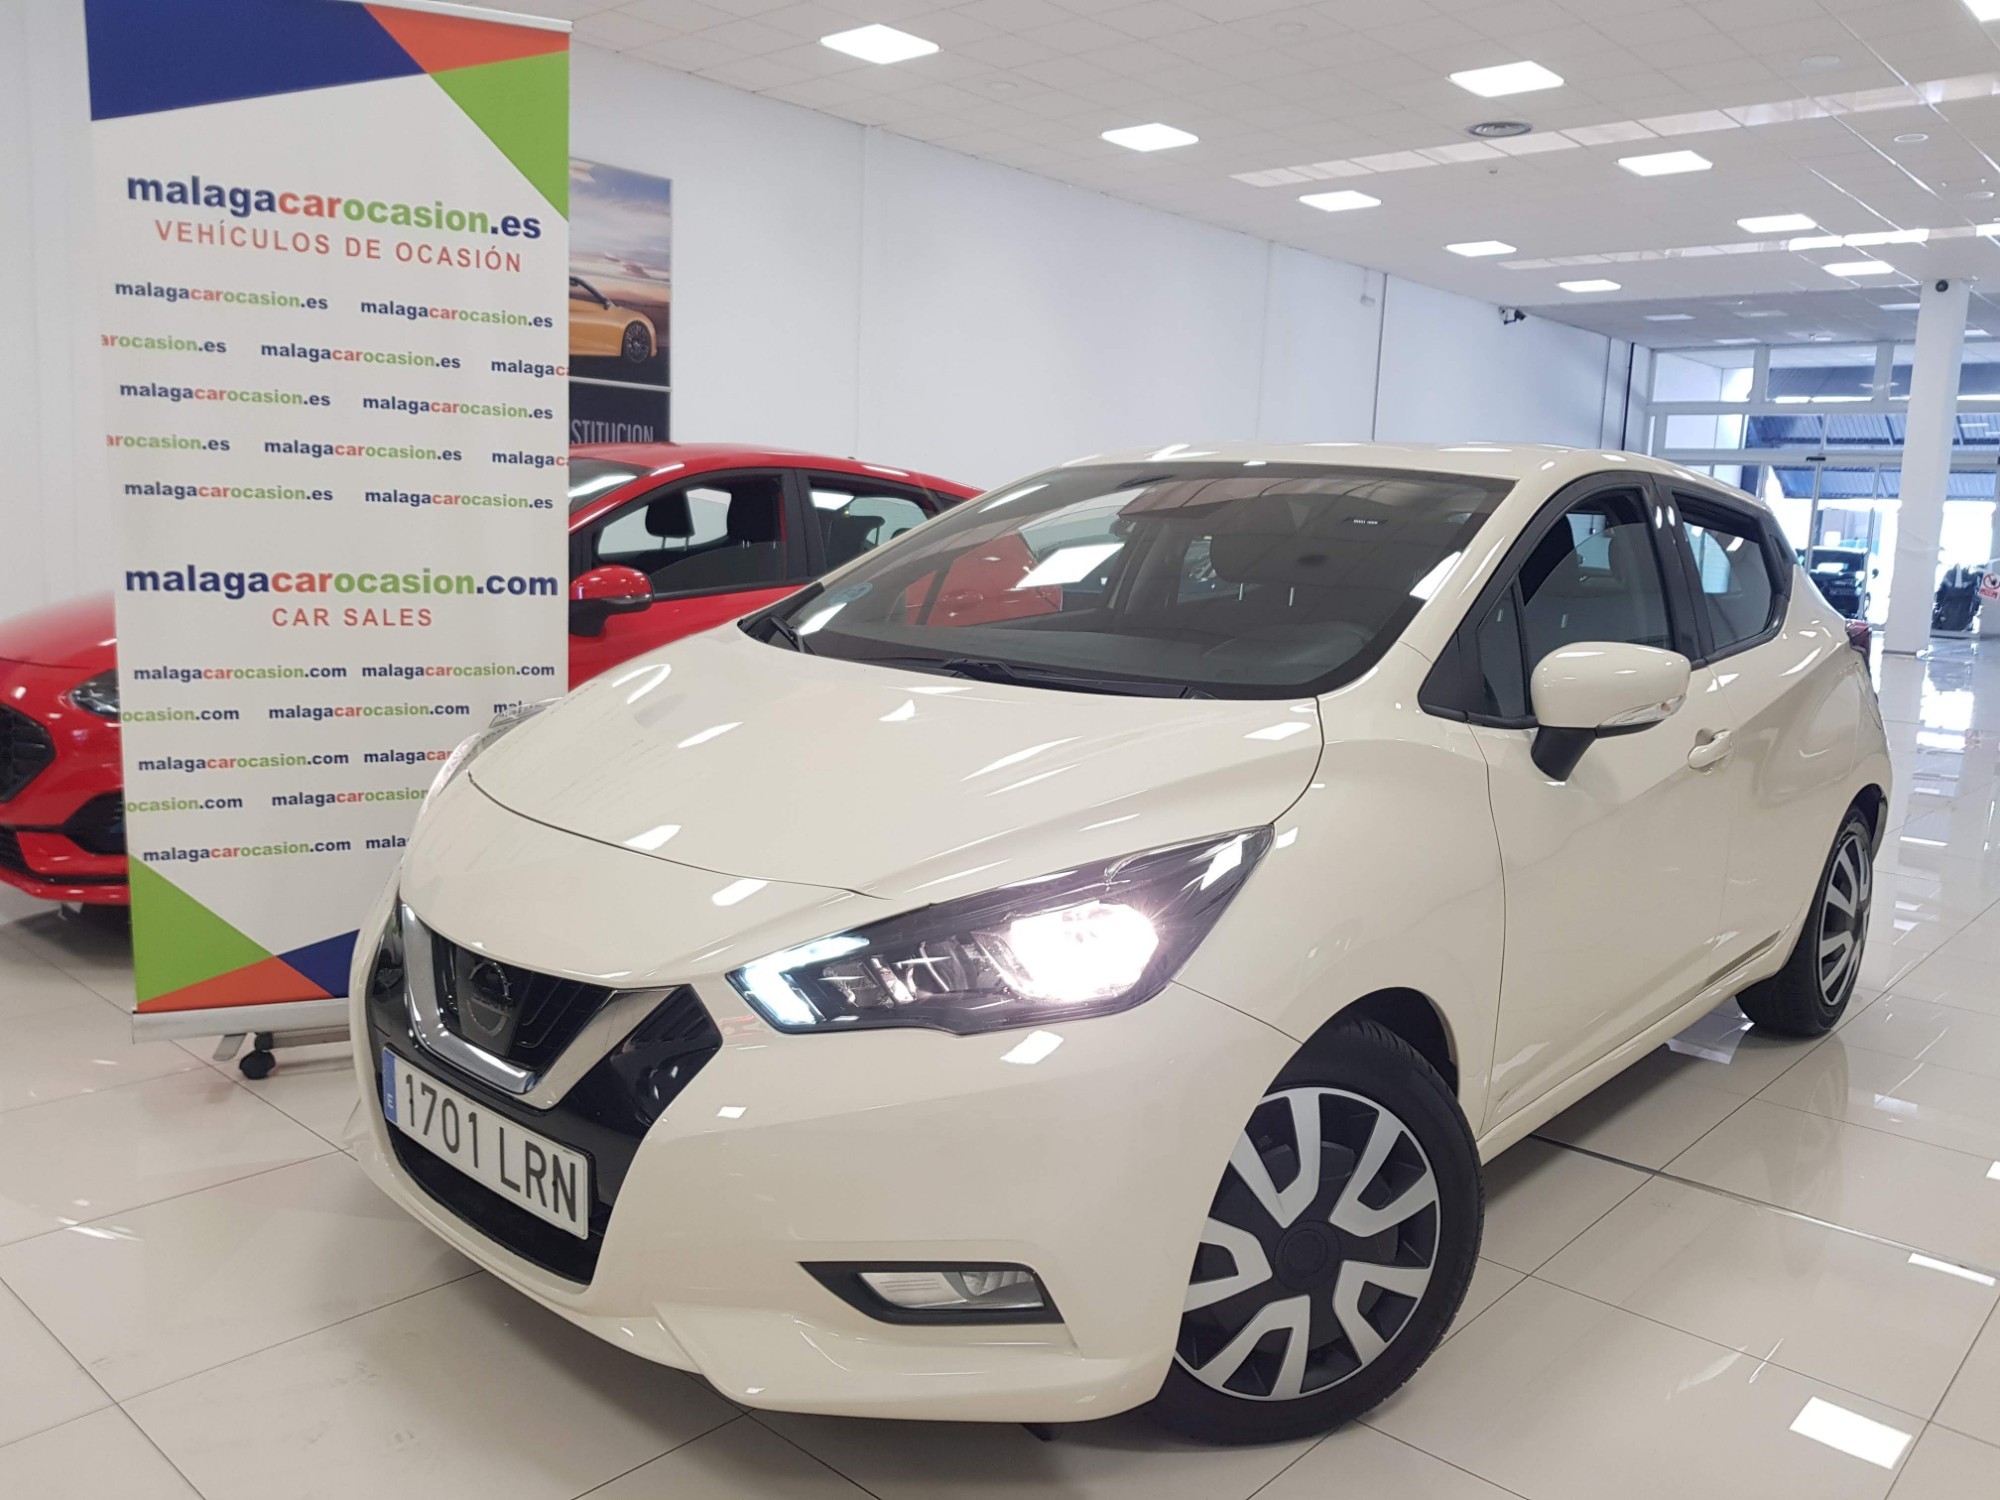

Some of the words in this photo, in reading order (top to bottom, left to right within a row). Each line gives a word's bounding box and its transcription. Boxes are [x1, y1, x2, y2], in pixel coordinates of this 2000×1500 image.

[127, 175, 541, 239] malagacarocasion.es
[155, 219, 330, 254] VEHÍCULOS
[345, 236, 382, 259] DE
[395, 242, 521, 272] OCASIÓN
[115, 281, 329, 310] malagacarocasion.es
[360, 299, 553, 328] malagacarocasion.es
[261, 342, 461, 369] malagacarocasion.es
[491, 359, 567, 378] malagac
[119, 382, 331, 407] malagacarocasion.es
[362, 395, 553, 419] malagacarocasion.es
[570, 418, 654, 445] STITUCION
[264, 439, 462, 462] malagacarocasion.es
[491, 450, 567, 469] malagac
[124, 481, 333, 501] malagacarocasion.es
[364, 489, 553, 509] malagacarocasion.es
[125, 564, 559, 600] malagacarocasion.com
[272, 607, 330, 627] CAR
[343, 607, 432, 627] SALES
[133, 664, 347, 683] malagacarocasion.com
[361, 663, 555, 680] malagacarocasion.com
[121, 706, 240, 722] ocasion.com
[268, 701, 470, 722] malagacarocasion.com
[138, 752, 349, 772] malagacarocasion.com
[126, 796, 243, 813] ocasion.com
[143, 840, 351, 864] malagacarocasion.com
[406, 1073, 479, 1169] 1701
[499, 1126, 577, 1222] LRN
